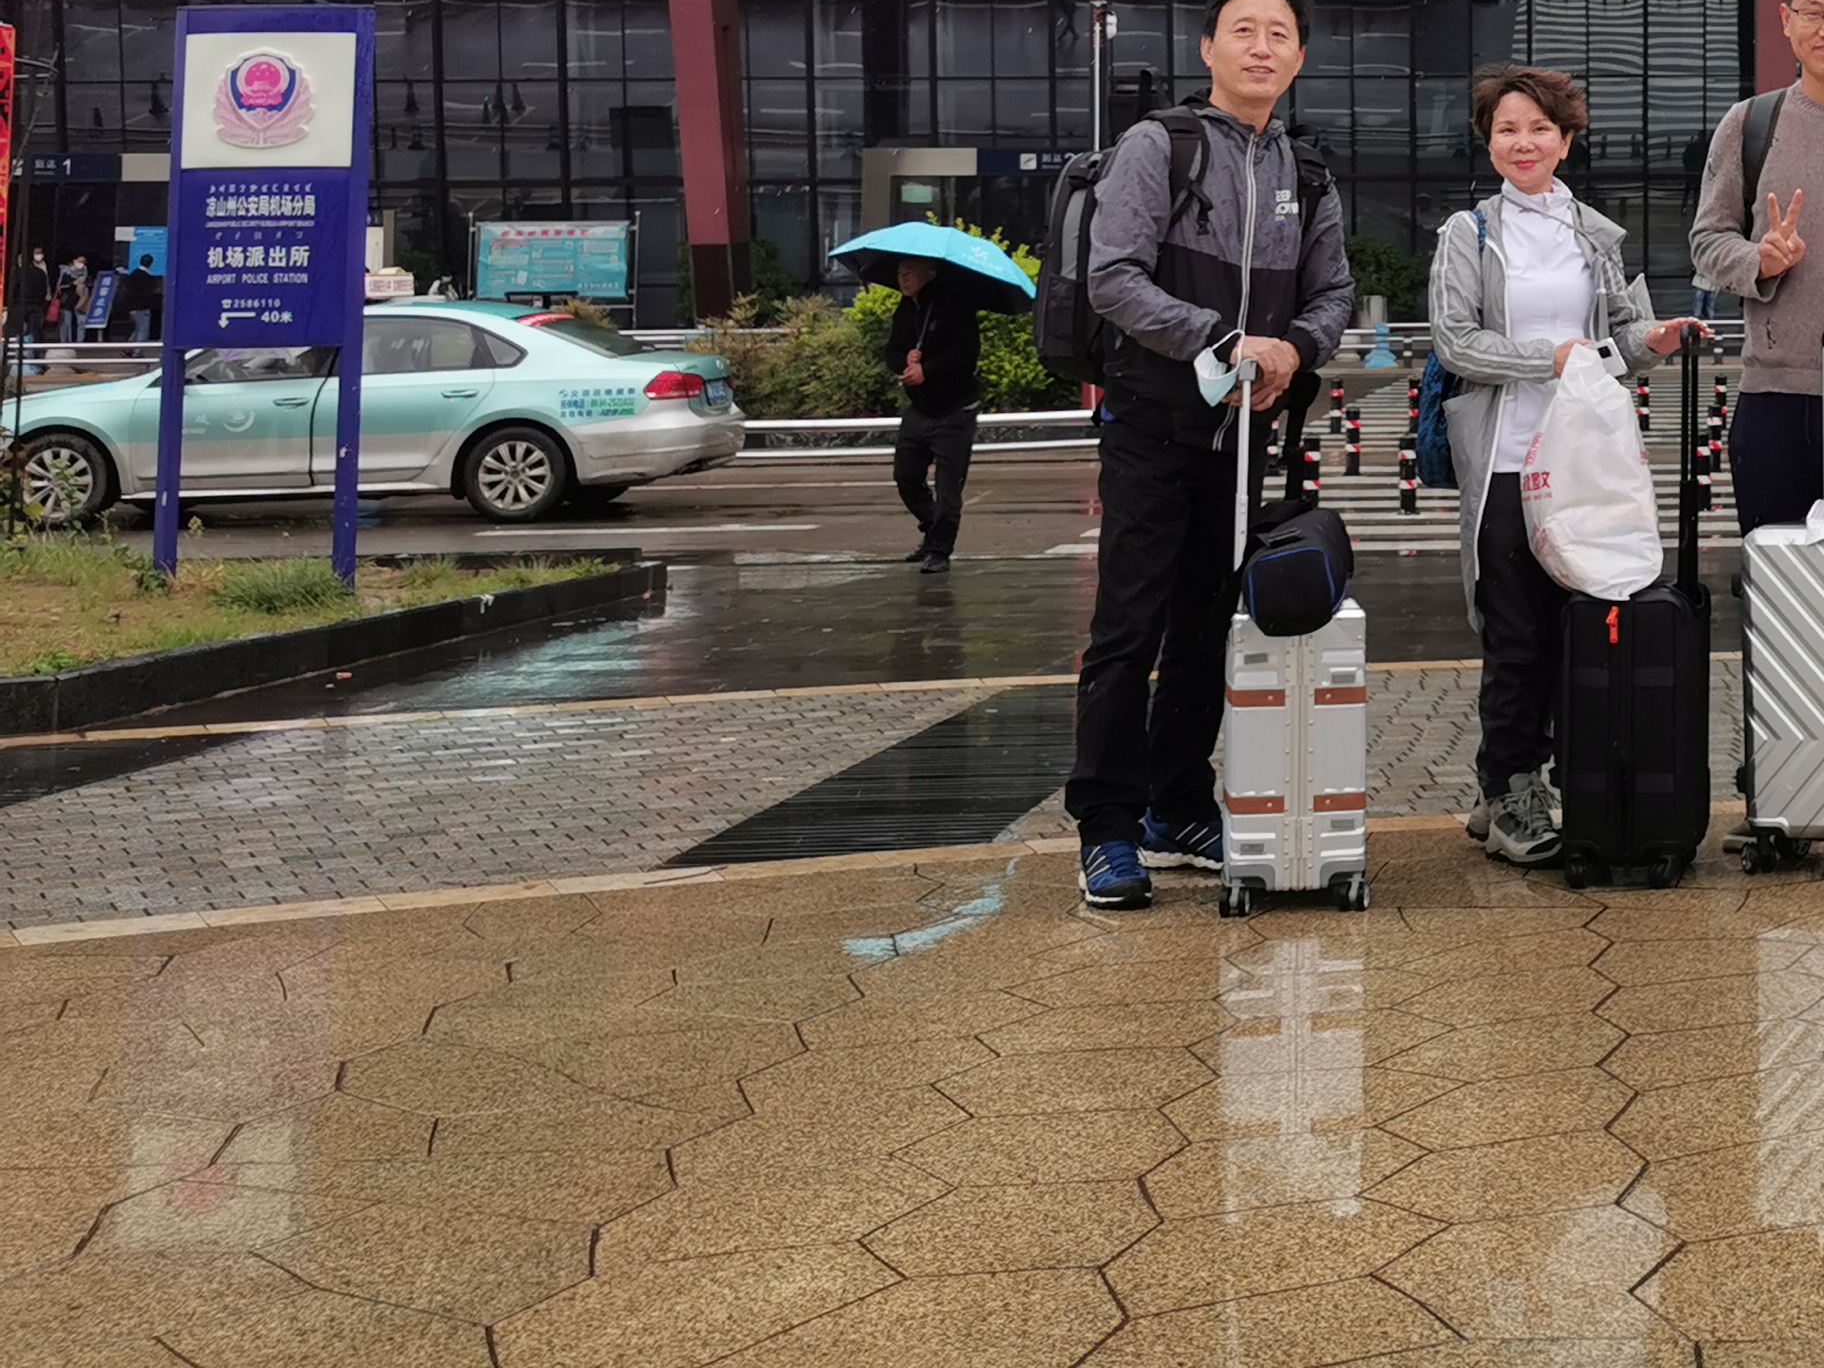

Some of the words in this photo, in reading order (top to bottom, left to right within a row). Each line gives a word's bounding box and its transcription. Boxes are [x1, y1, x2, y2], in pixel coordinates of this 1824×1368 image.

[62, 158, 72, 176] 1
[205, 194, 316, 218] 凉山州公安局机场分局
[206, 245, 310, 269] 机场派出所
[206, 273, 236, 284] AIRPORT
[242, 273, 269, 284] POLICE
[273, 272, 309, 284] STATION
[260, 311, 293, 324] 40米
